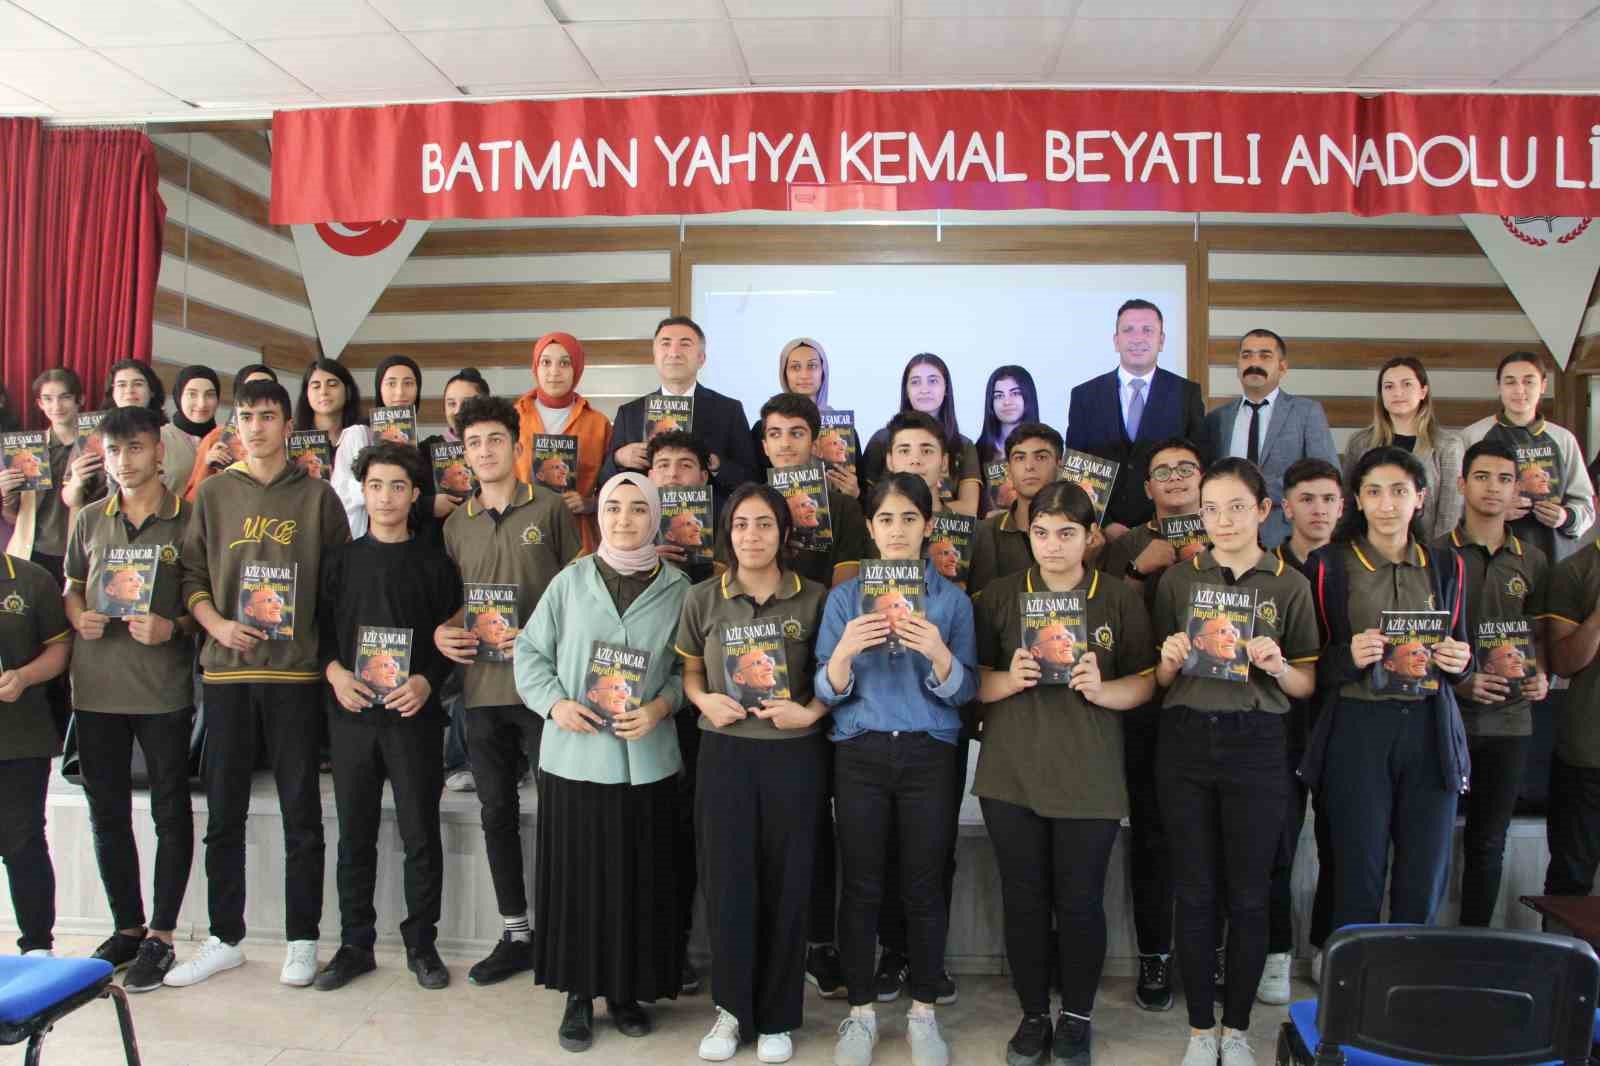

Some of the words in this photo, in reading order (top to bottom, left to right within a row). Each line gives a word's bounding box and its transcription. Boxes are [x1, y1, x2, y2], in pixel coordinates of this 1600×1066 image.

[422, 137, 638, 193] BATMAN
[654, 130, 826, 188] YAHYA
[840, 130, 1028, 183] KEMAL
[1045, 129, 1262, 185] BEYATLI
[1280, 133, 1538, 188] ANADOLU
[260, 566, 291, 579] SANCAR
[865, 565, 884, 579] AZİZ
[885, 566, 919, 580] SANCAR
[485, 589, 514, 601] SANCAR
[1194, 588, 1214, 605] AZİZ
[1215, 591, 1250, 608] SANCAR
[1044, 598, 1079, 611] SANCAR
[1386, 616, 1405, 631] AZİZ
[1406, 618, 1442, 631] SANCAR
[1495, 619, 1528, 633] SANCAR
[378, 631, 407, 645] SANCAR
[725, 626, 743, 641] AZİZ
[743, 623, 776, 640] SANCAR
[613, 648, 645, 669] SANCAR
